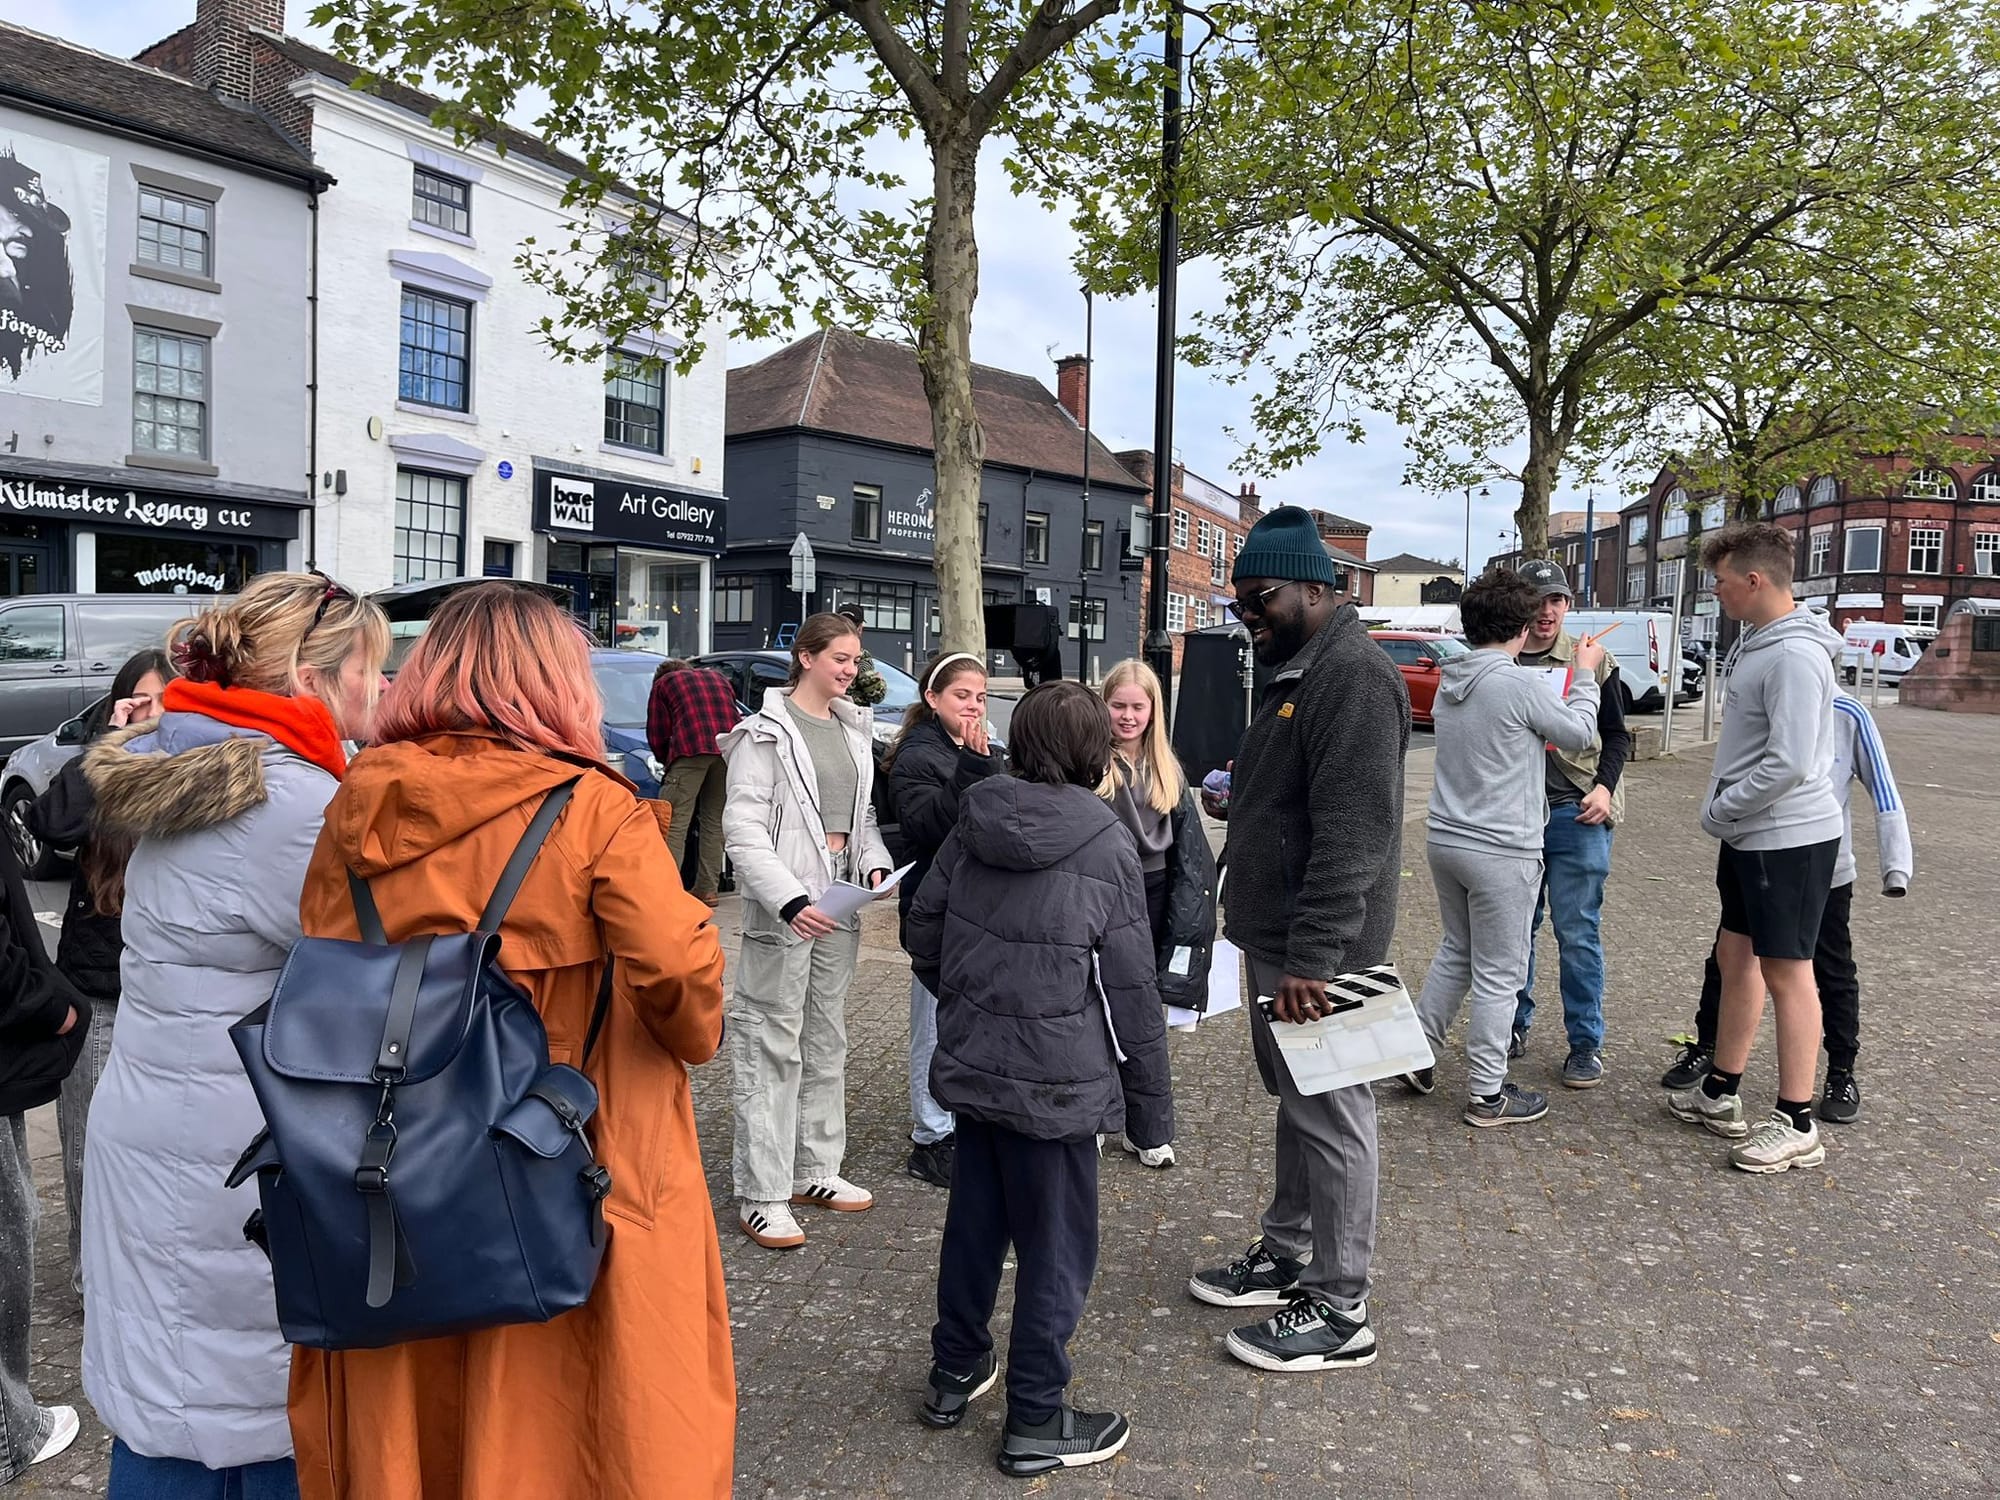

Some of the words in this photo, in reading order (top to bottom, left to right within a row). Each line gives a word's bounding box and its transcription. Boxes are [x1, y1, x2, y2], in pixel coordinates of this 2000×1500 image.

[124, 491, 208, 530] Legacy
[554, 485, 593, 507] bare
[619, 492, 648, 515] Art
[651, 496, 715, 529] Gallery
[554, 504, 593, 524] WALL
